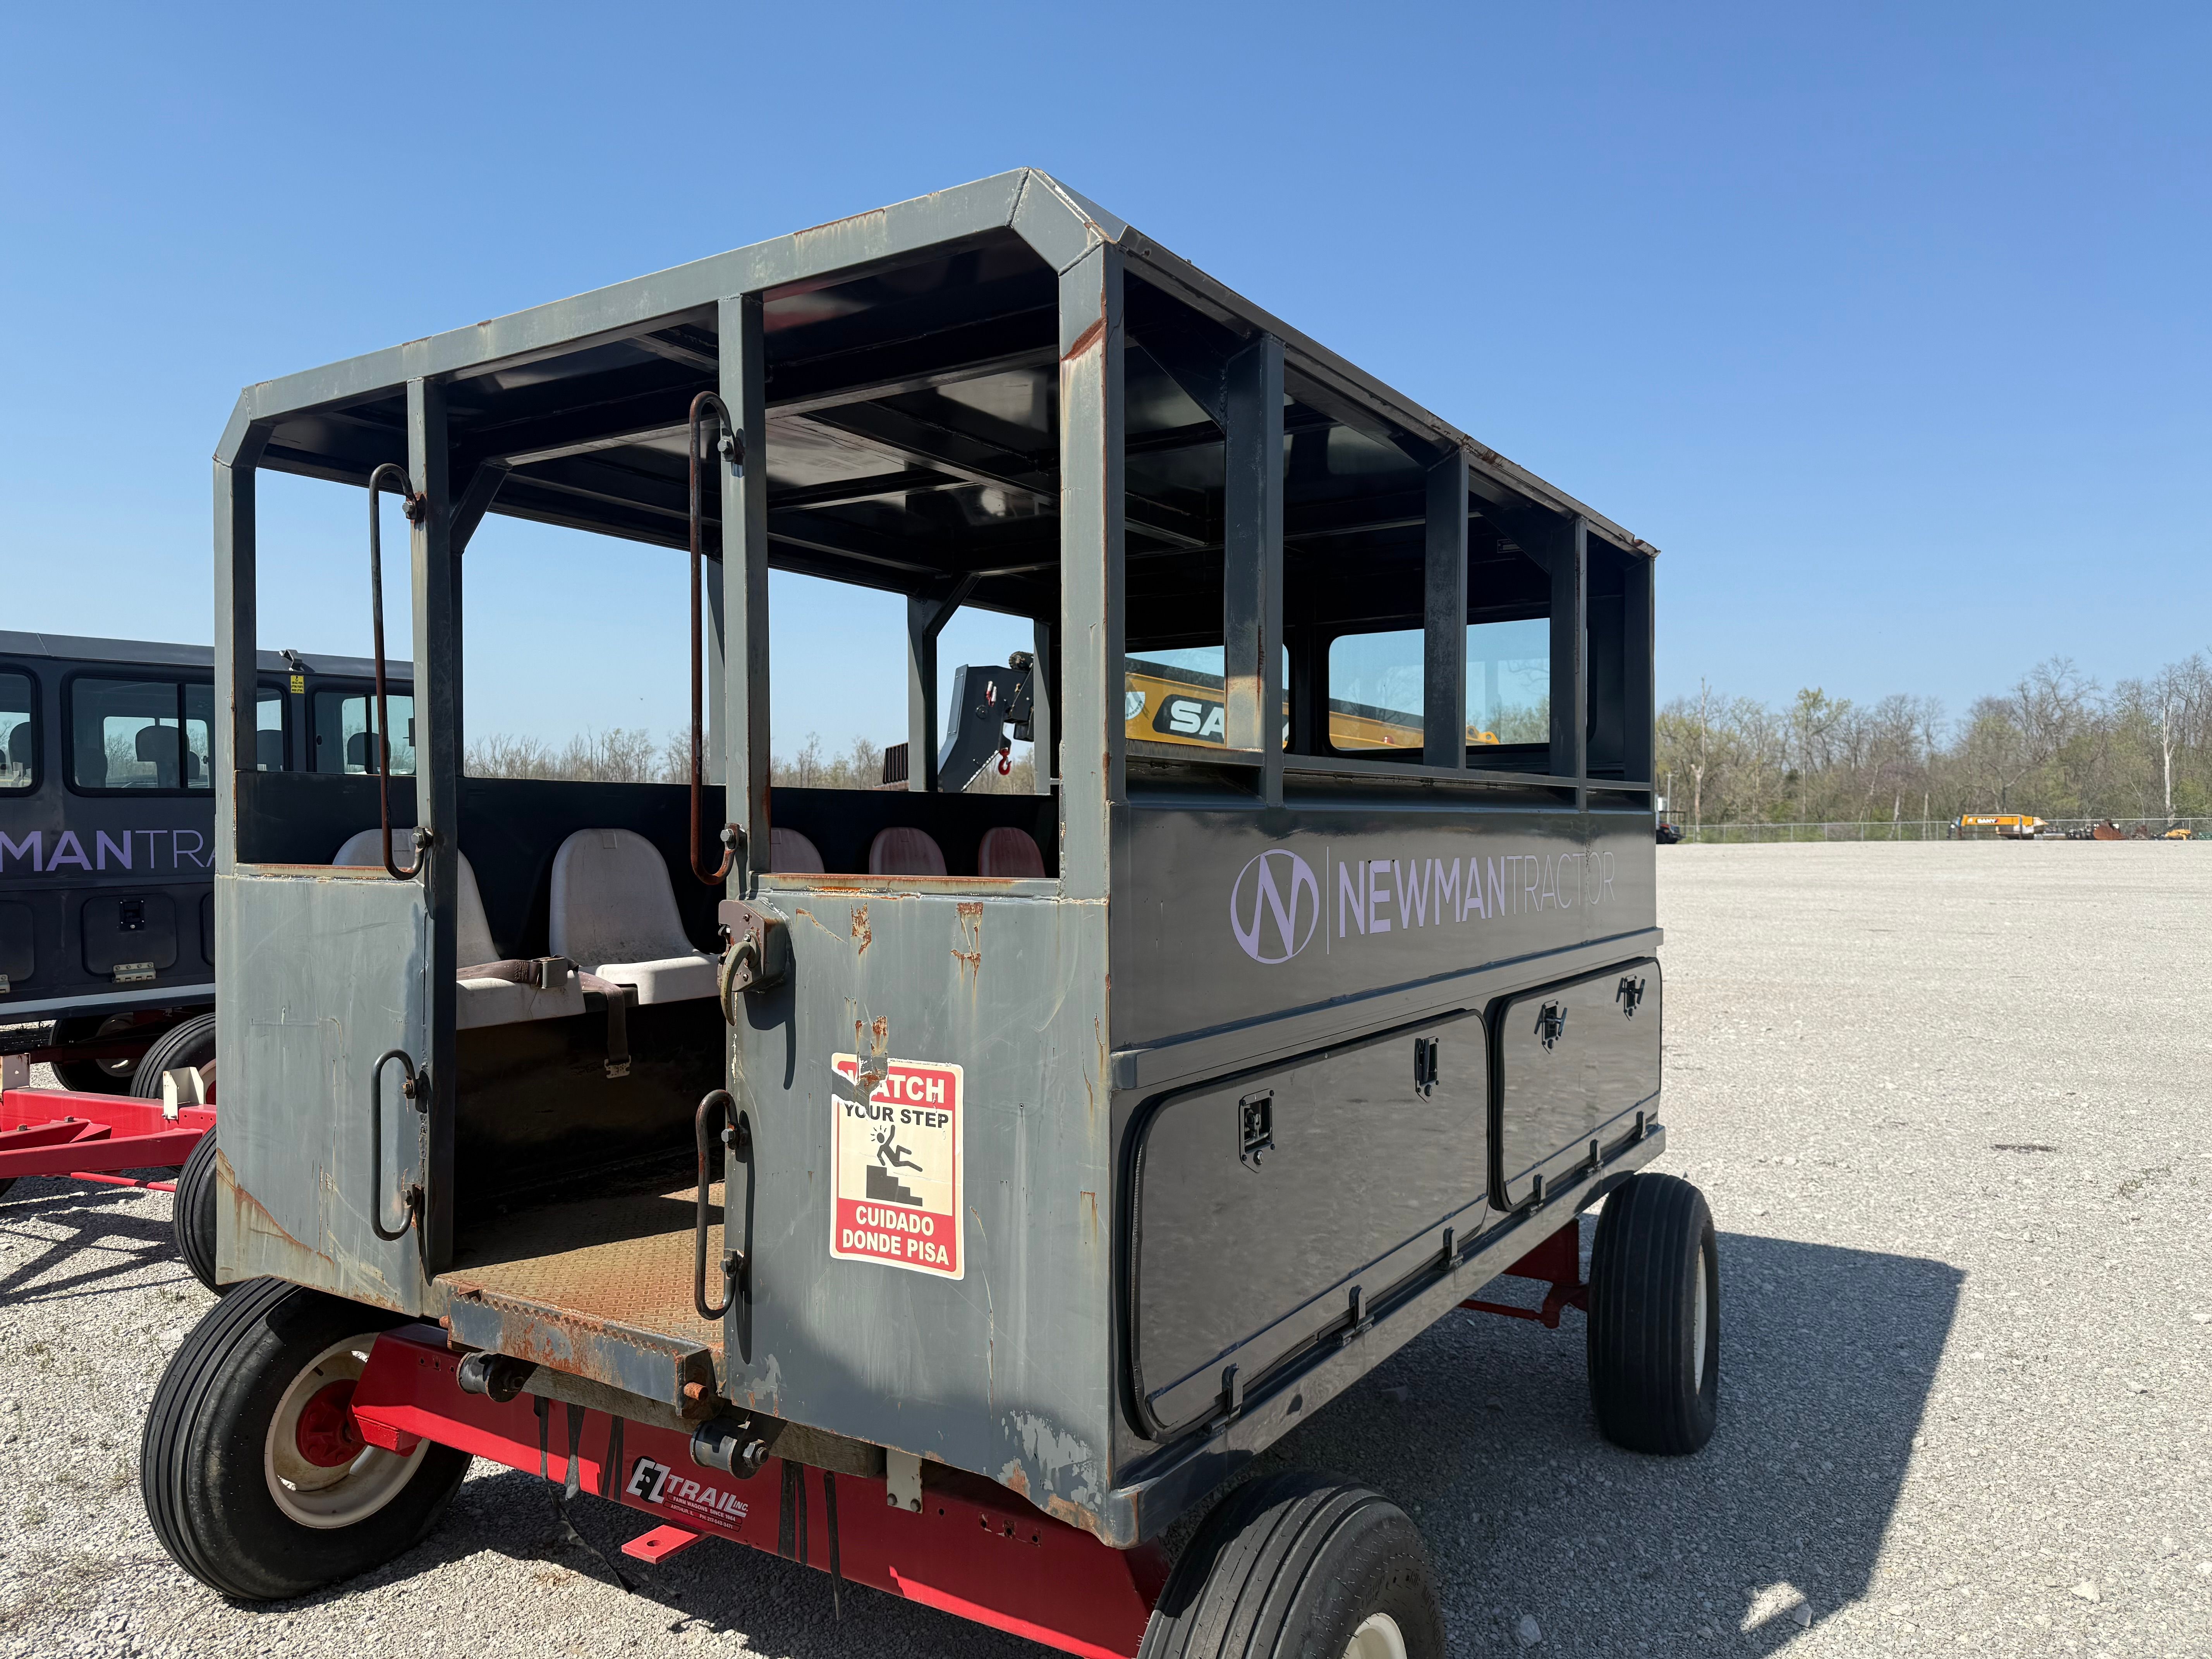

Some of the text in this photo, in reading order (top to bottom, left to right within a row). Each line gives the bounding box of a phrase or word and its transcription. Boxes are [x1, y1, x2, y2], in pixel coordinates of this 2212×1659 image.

[0, 830, 215, 872] MANTR
[847, 1069, 945, 1103] ATCH
[900, 1109, 949, 1128] STEP
[856, 1205, 934, 1236] CUIDADO
[843, 1228, 950, 1266] DONDE PISA
[667, 1474, 747, 1518] TRAIL
[733, 1500, 748, 1511] INC.
[673, 1496, 686, 1505] FARM
[687, 1501, 708, 1512] WAGONS
[710, 1509, 724, 1518] SINCE
